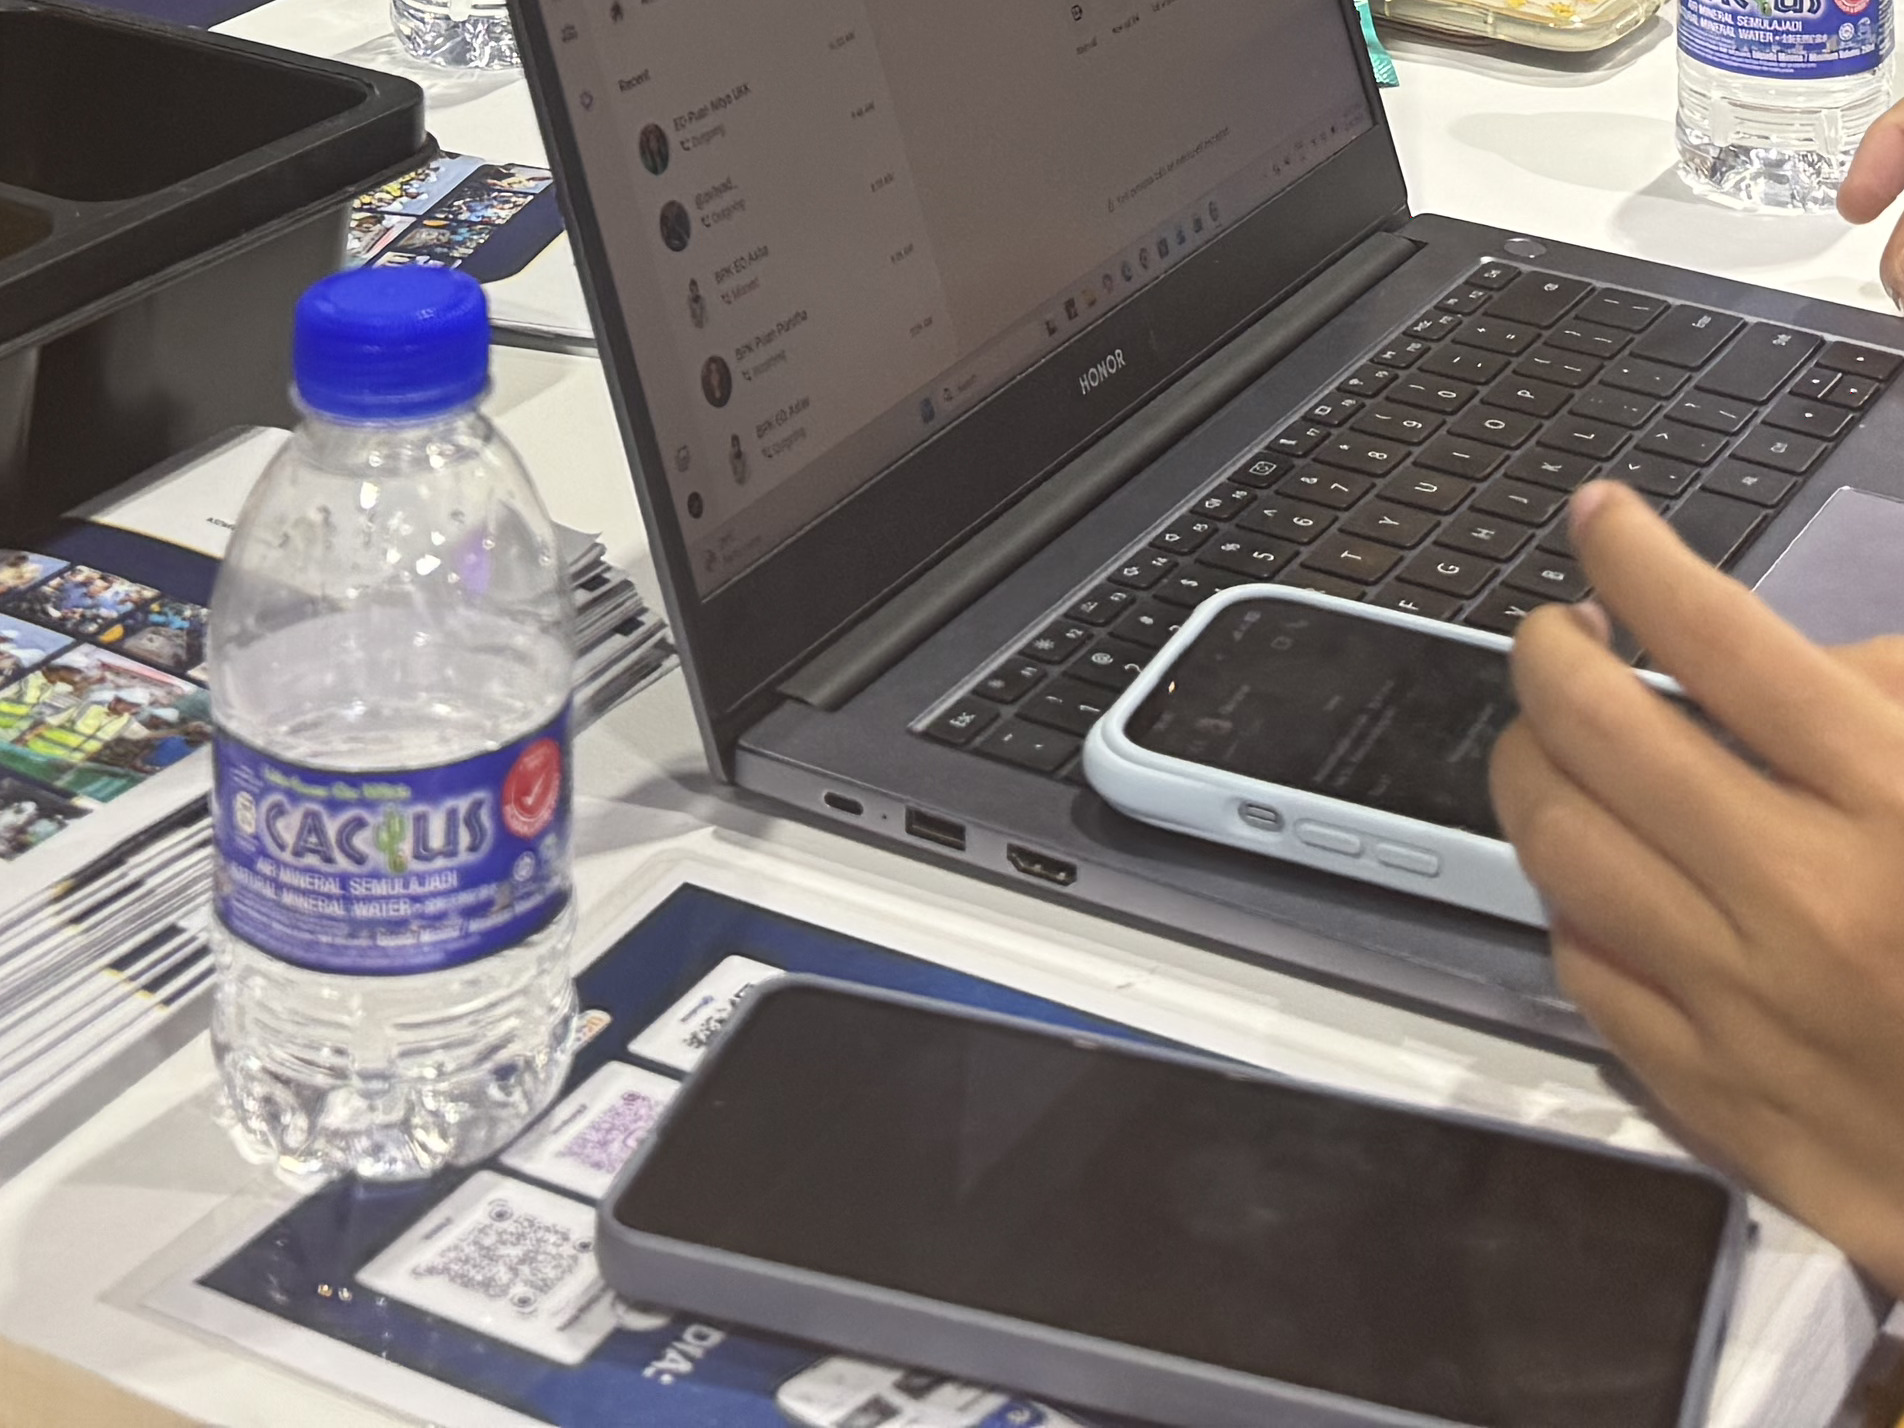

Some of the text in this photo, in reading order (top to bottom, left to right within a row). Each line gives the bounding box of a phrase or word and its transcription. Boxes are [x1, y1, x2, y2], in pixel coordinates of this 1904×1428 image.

[1699, 3, 1734, 26] MINERAL
[1736, 15, 1802, 32] SEMULAJADI
[1700, 20, 1736, 39] MINERAL
[1738, 28, 1773, 43] WATER
[1077, 348, 1127, 395] HONOR
[279, 866, 345, 895] MINERAL
[349, 870, 458, 895] SEMULAJADI
[282, 892, 346, 916] MINERAL
[352, 897, 412, 917] WATER
